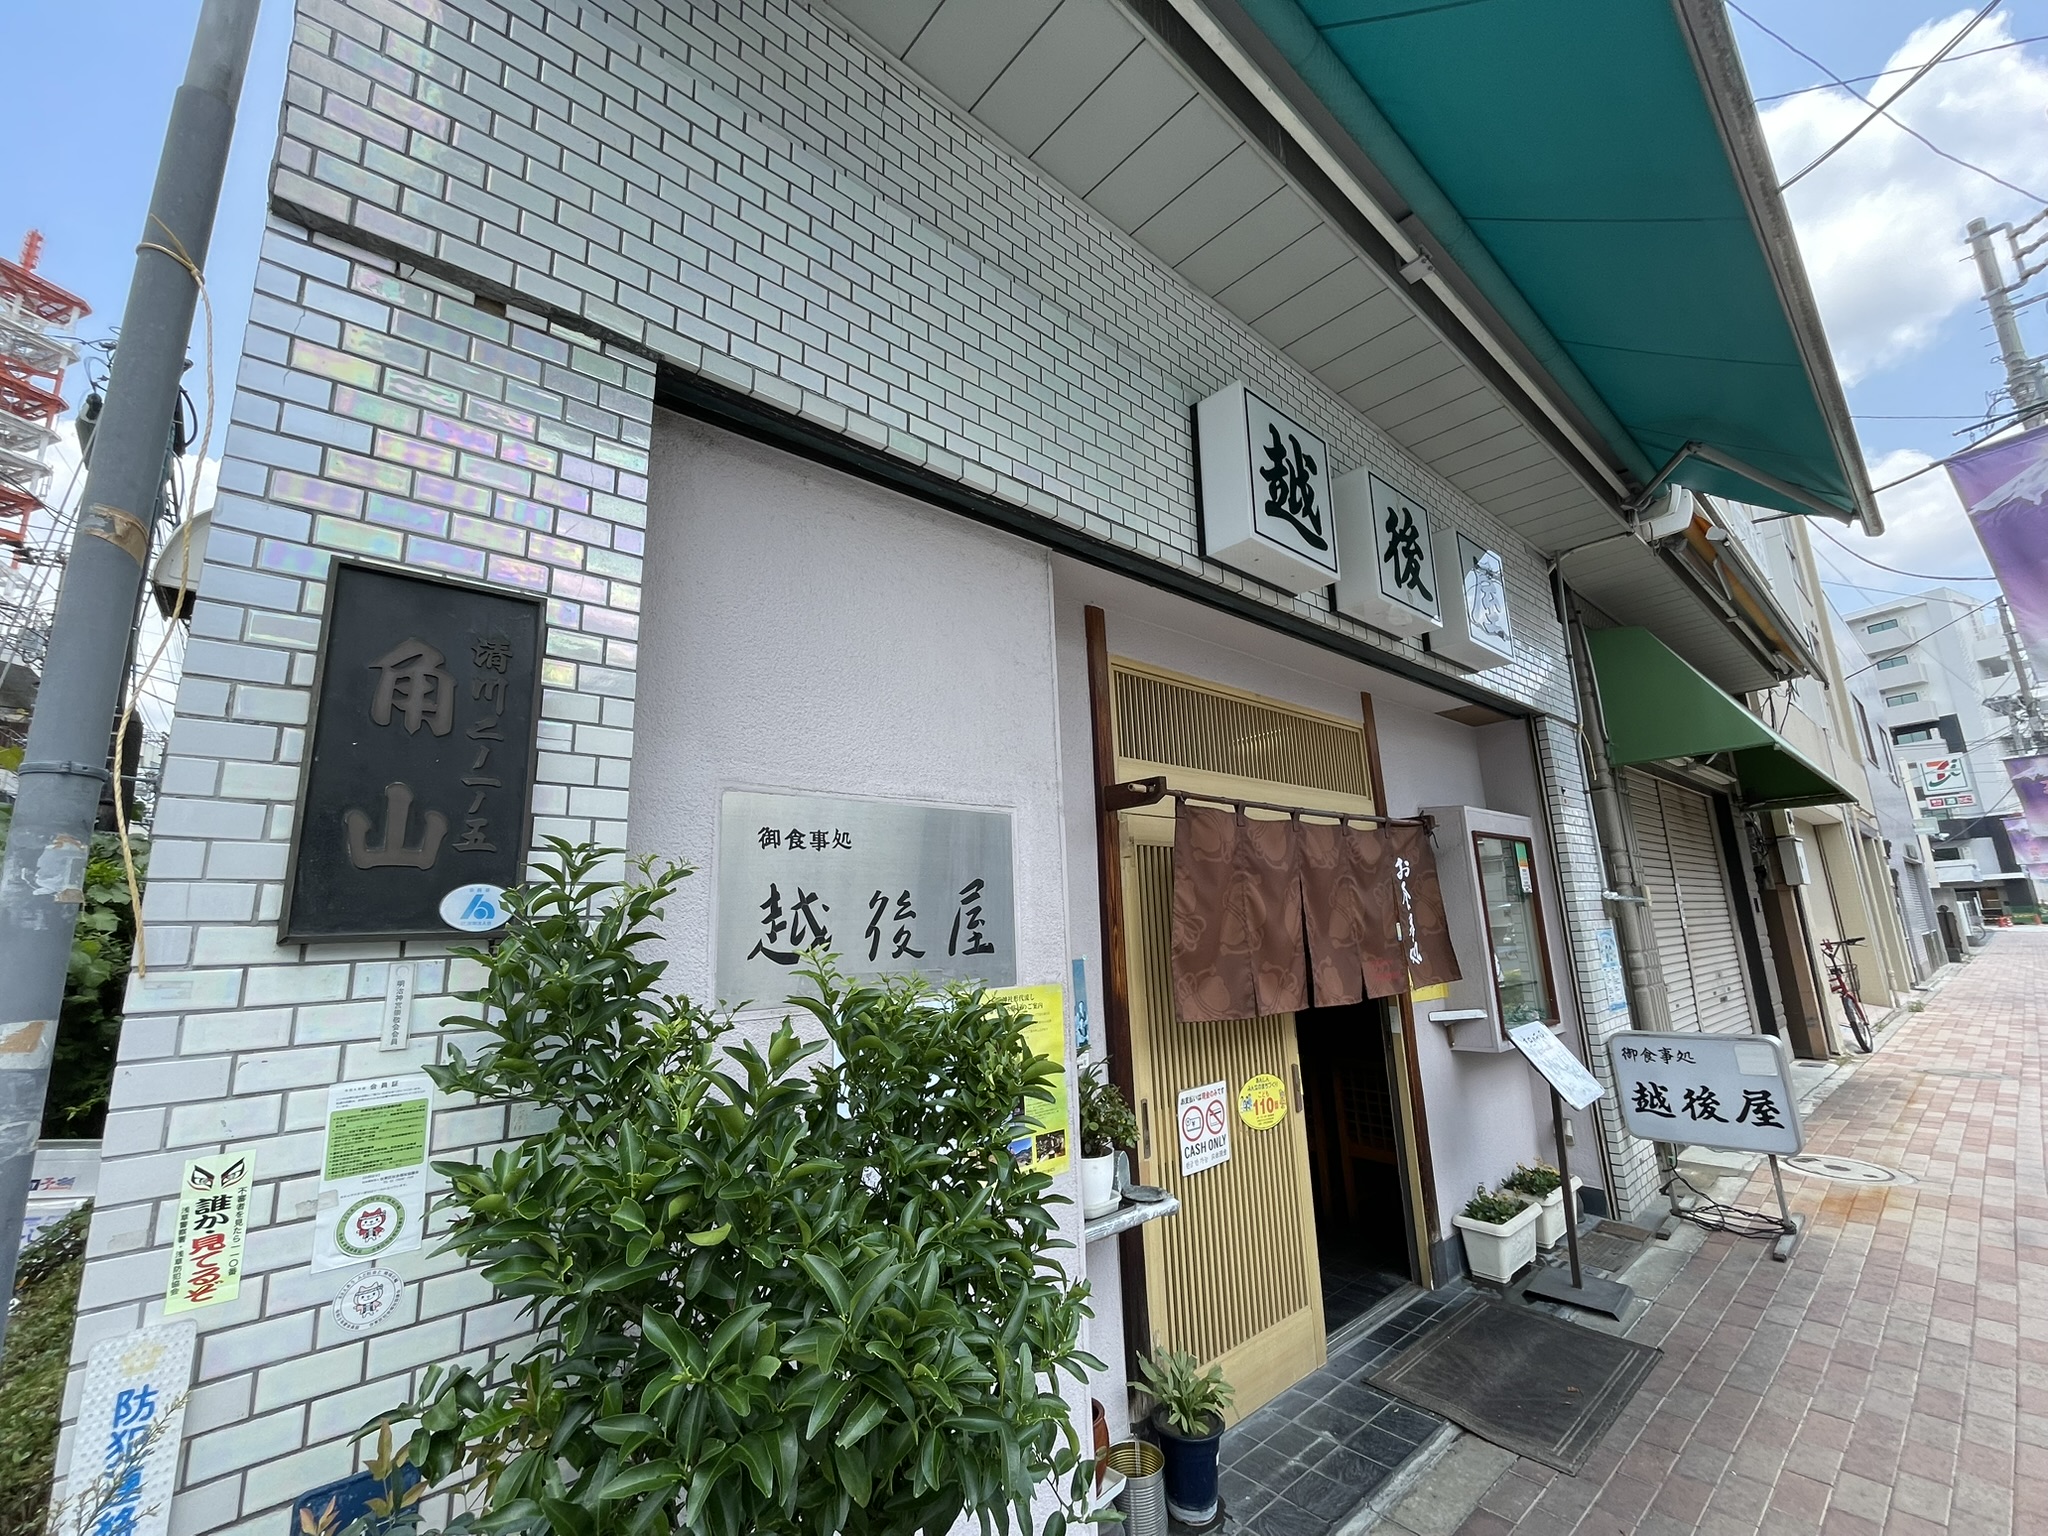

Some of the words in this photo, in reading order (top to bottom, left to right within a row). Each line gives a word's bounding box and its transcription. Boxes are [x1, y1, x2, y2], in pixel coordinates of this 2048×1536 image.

[344, 637, 457, 870] 角山
[757, 826, 852, 852] 御食事処
[747, 878, 995, 966] 越後屋
[1621, 1047, 1697, 1065] 御食事処
[1631, 1081, 1786, 1130] 越後屋
[1184, 1141, 1207, 1159] CASH
[1208, 1133, 1227, 1151] ONLY
